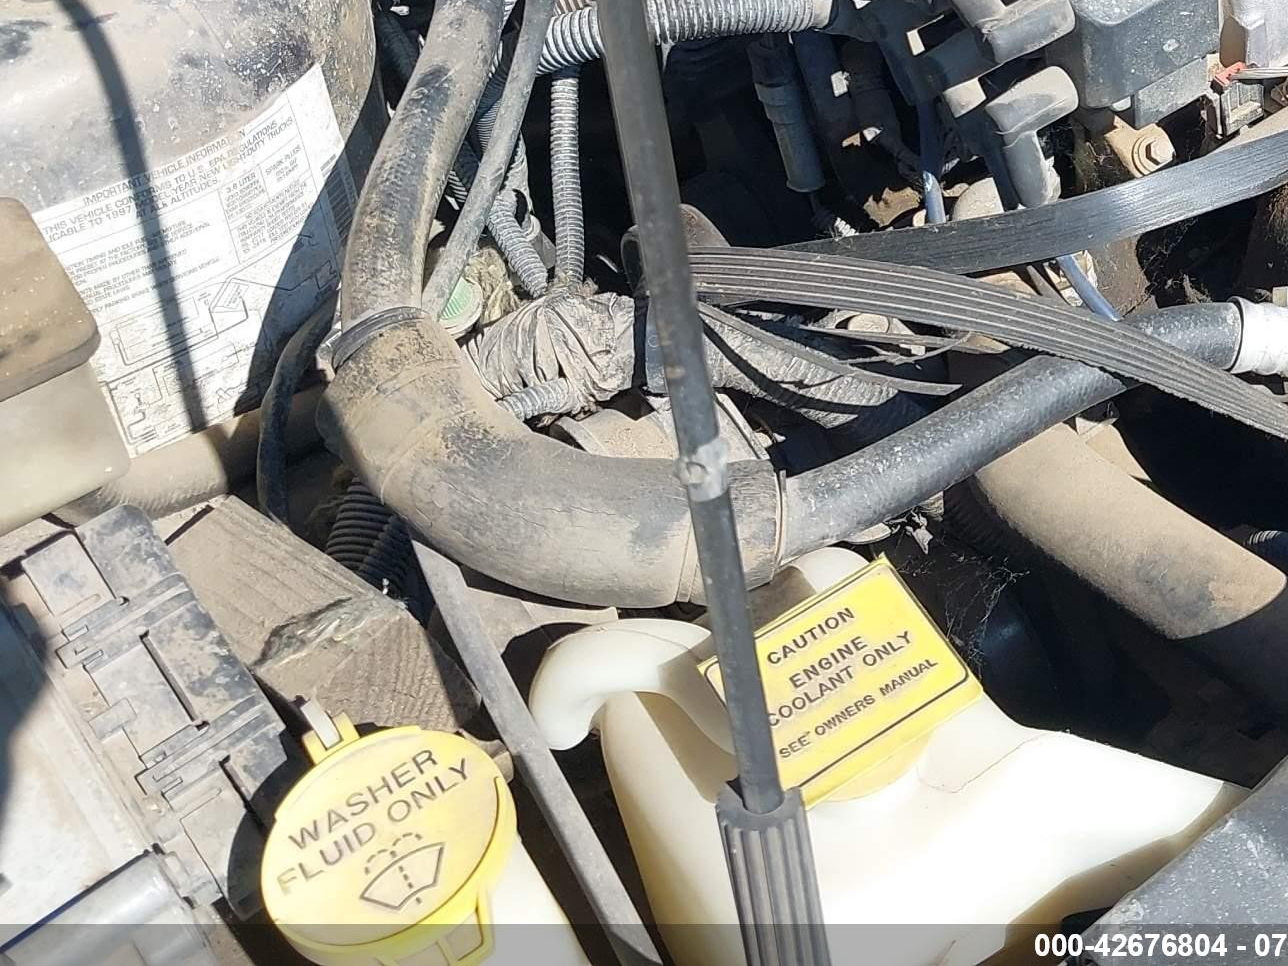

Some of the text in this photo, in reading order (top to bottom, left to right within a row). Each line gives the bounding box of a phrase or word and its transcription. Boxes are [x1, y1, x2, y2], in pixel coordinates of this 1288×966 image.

[46, 220, 68, 235] THIS
[68, 201, 113, 226] VEHICLE
[173, 171, 187, 184] TO
[81, 175, 143, 208] IMPORTANT
[142, 157, 185, 184] VEHICLE
[86, 215, 102, 228] TO
[171, 177, 198, 194] YEAR
[197, 165, 221, 182] NEW
[236, 171, 258, 187] LITER
[767, 607, 855, 665] CAUTION
[789, 635, 868, 689] ENGINE
[767, 630, 911, 727] COOLANT ONLY
[779, 658, 938, 758] SEE OWNERS MANUAL
[276, 757, 470, 896] FLUID ONLY
[288, 749, 438, 850] WASHER
